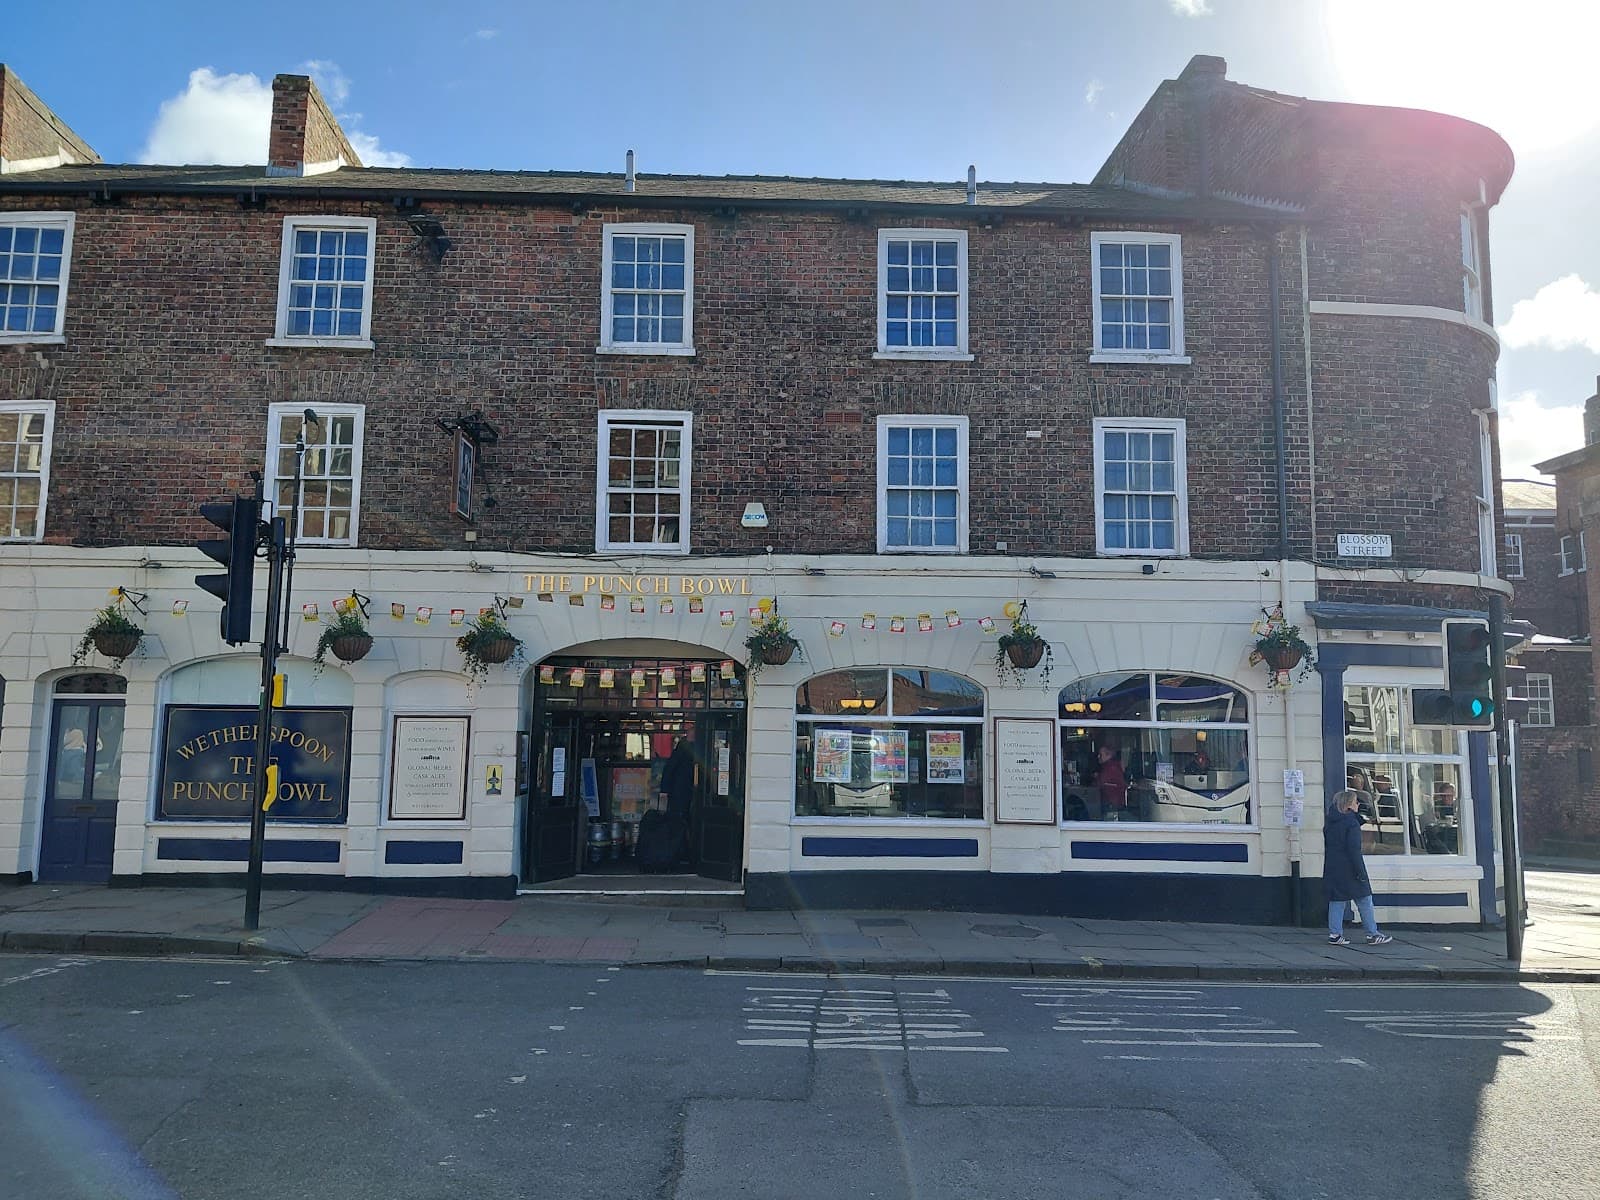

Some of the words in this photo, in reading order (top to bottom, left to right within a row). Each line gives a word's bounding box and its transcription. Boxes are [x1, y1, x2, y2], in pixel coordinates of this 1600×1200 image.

[1340, 535, 1388, 545] BLOSSOM
[1345, 545, 1384, 555] STREET
[524, 574, 572, 593] THE
[583, 575, 670, 594] PUNCH
[680, 577, 753, 595] BOWL
[229, 756, 278, 775] TH
[172, 781, 255, 801] PUNCH
[278, 782, 334, 802] OWL
